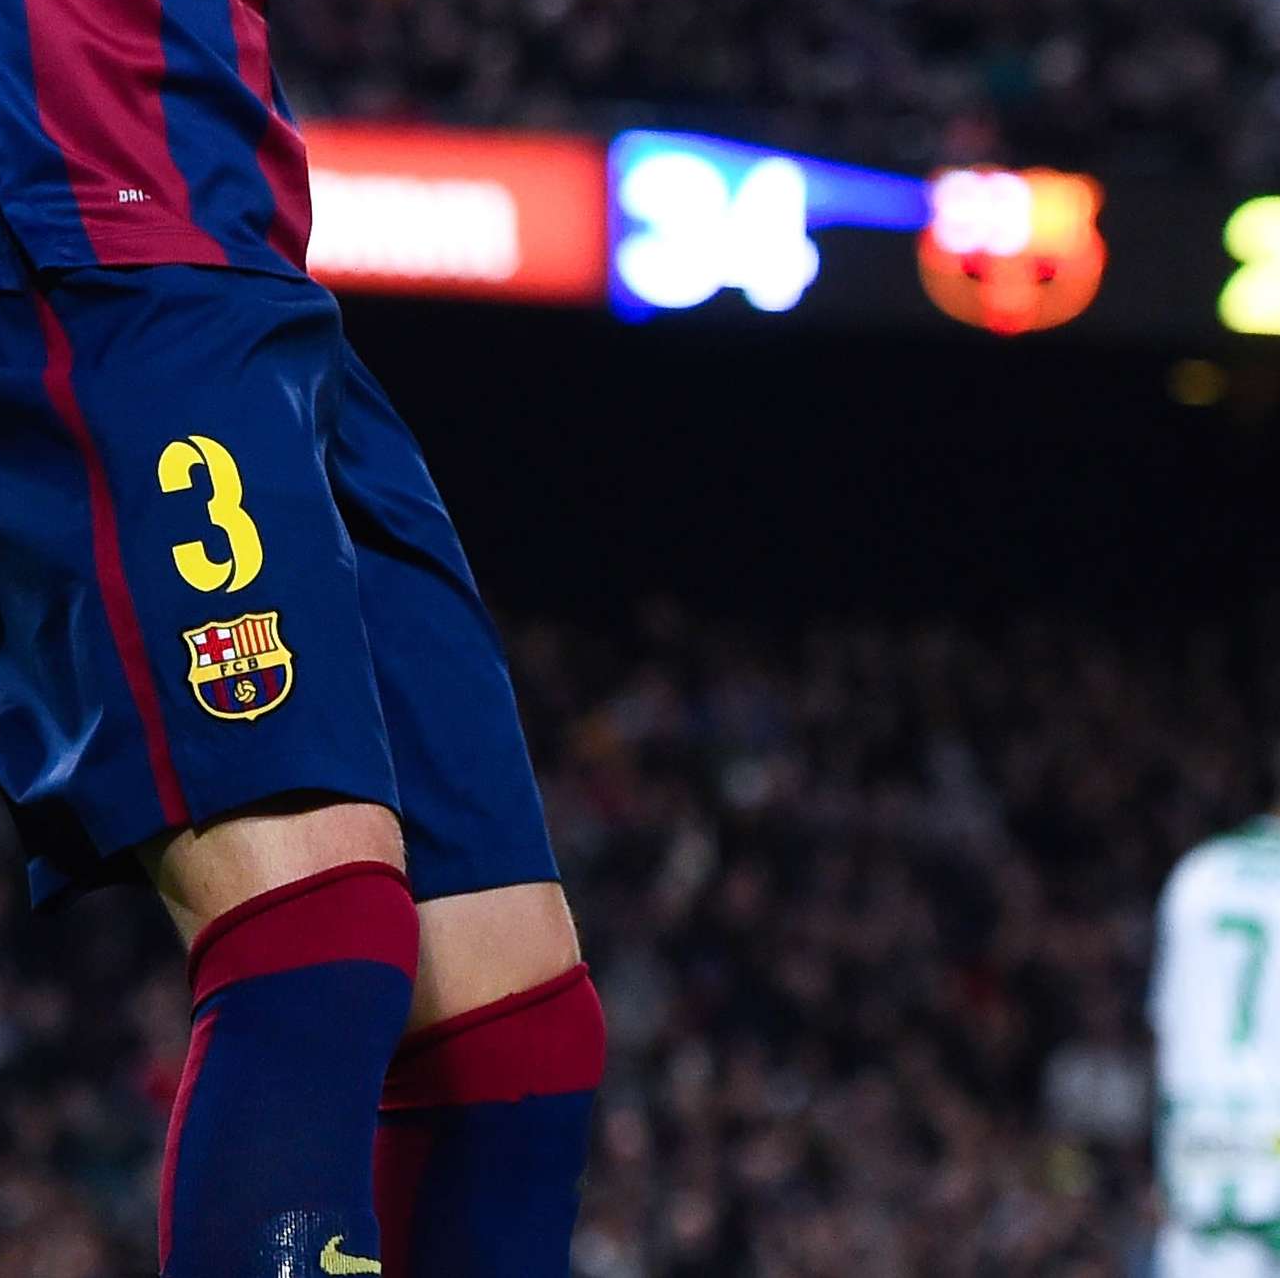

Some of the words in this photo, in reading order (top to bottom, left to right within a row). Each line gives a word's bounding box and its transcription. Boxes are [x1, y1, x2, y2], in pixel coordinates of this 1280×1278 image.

[157, 434, 265, 593] 3
[219, 657, 260, 678] FCB
[1208, 912, 1275, 1056] 7
